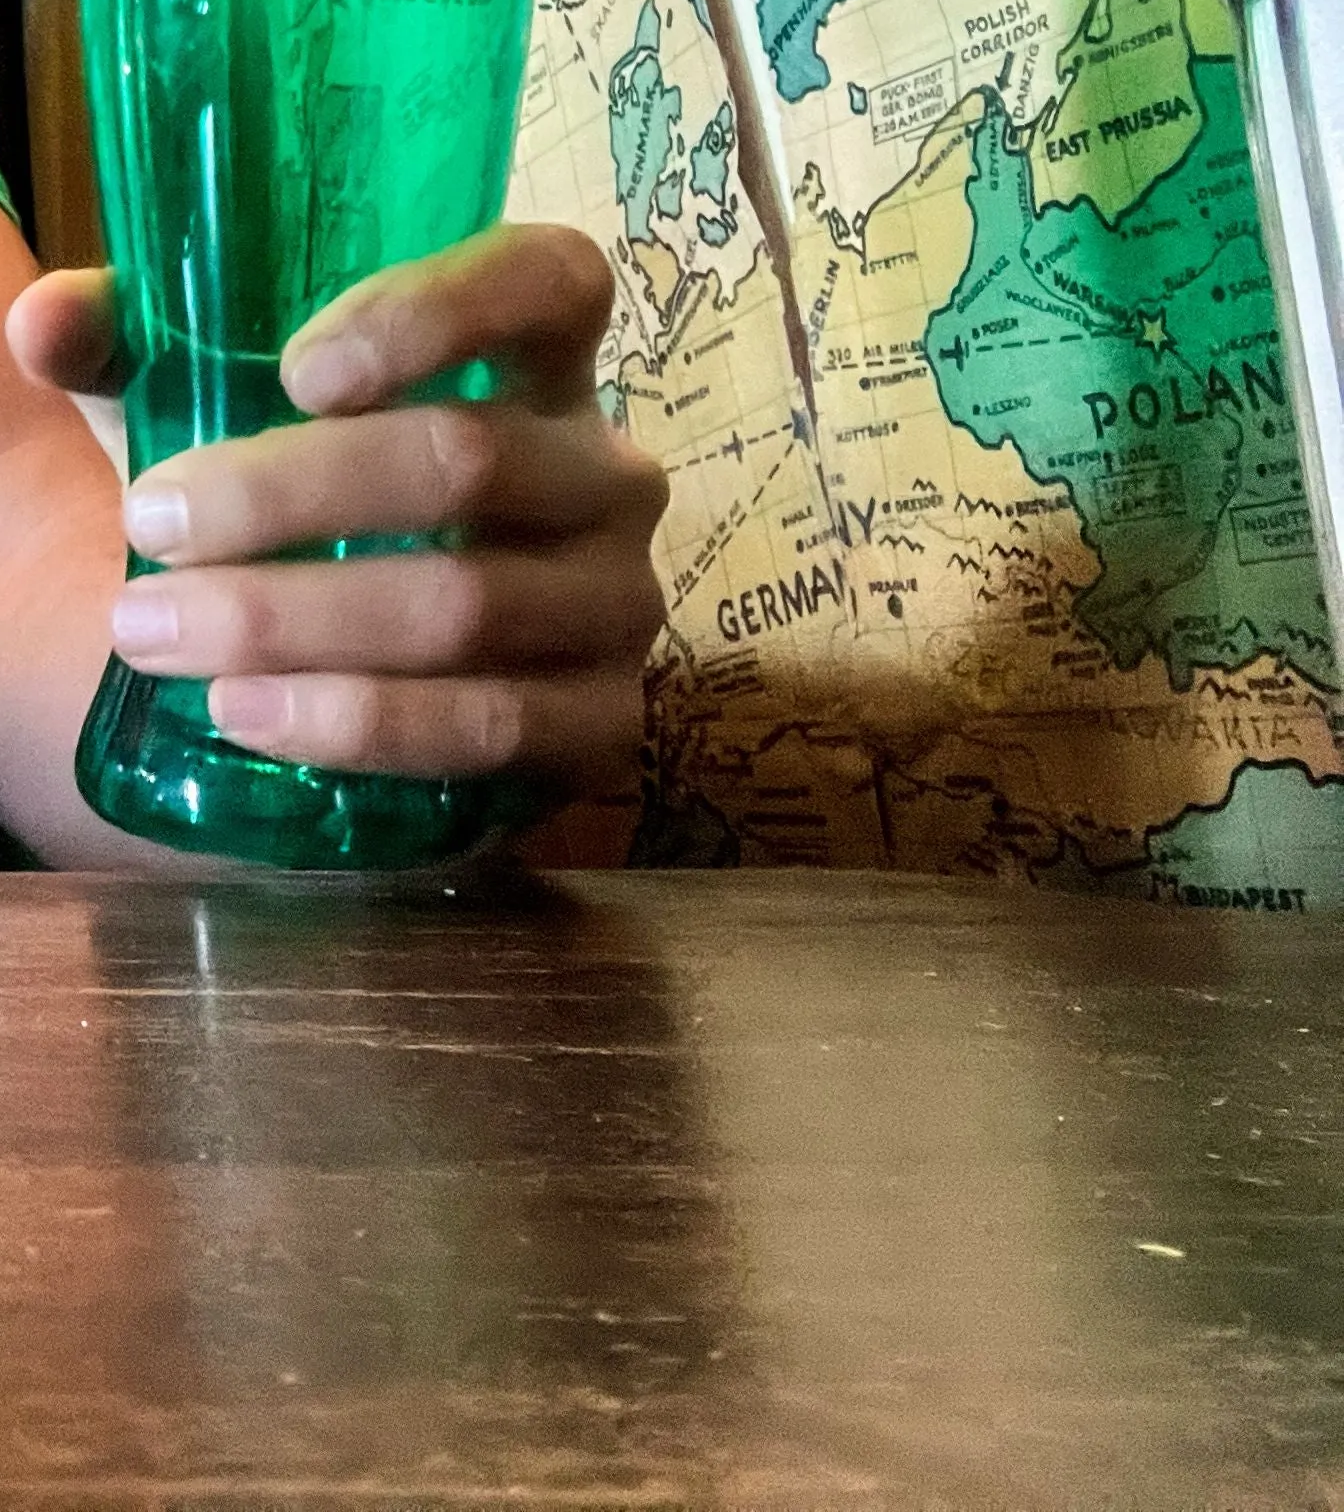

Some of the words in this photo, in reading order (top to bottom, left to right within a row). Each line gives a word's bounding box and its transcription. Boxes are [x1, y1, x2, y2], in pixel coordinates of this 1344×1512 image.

[960, 14, 1051, 64] CORRIDOR
[1013, 43, 1040, 120] DANZIG
[626, 86, 657, 199] DENMARK
[1045, 129, 1092, 163] EAST
[1097, 95, 1193, 145] PRUSSIA
[1082, 354, 1287, 439] POLAN
